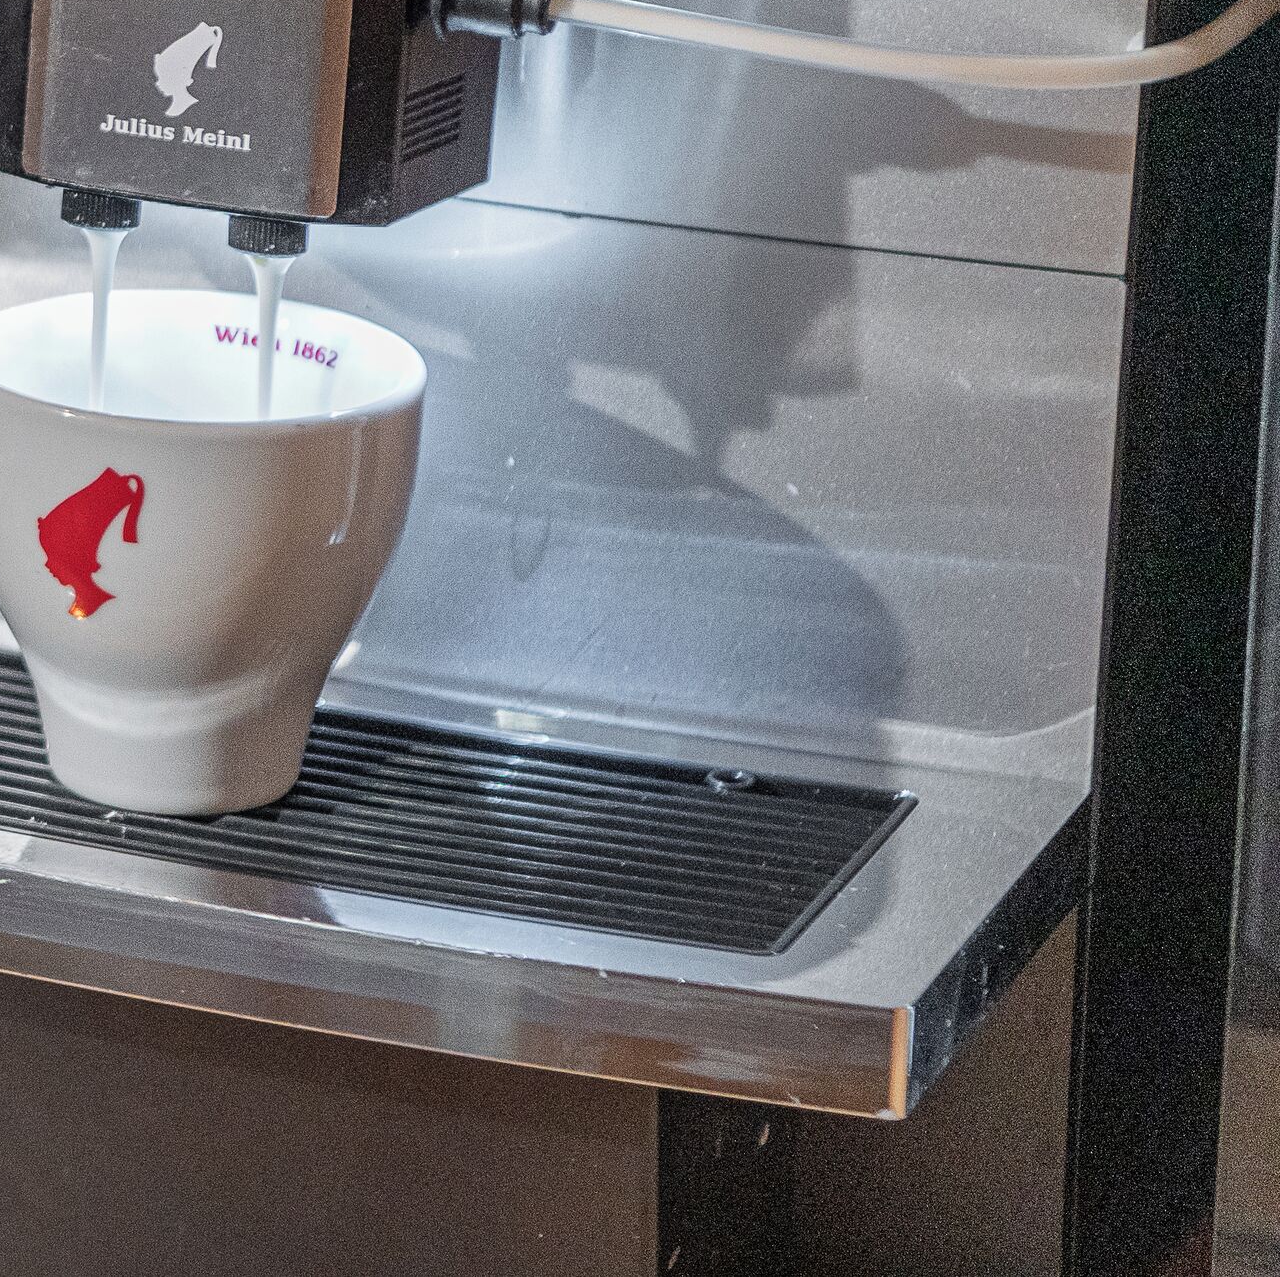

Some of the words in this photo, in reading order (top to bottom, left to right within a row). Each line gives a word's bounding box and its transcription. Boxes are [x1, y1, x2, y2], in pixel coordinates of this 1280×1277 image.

[100, 114, 175, 141] Julius
[182, 126, 251, 151] Meinl
[293, 339, 338, 368] 1862
